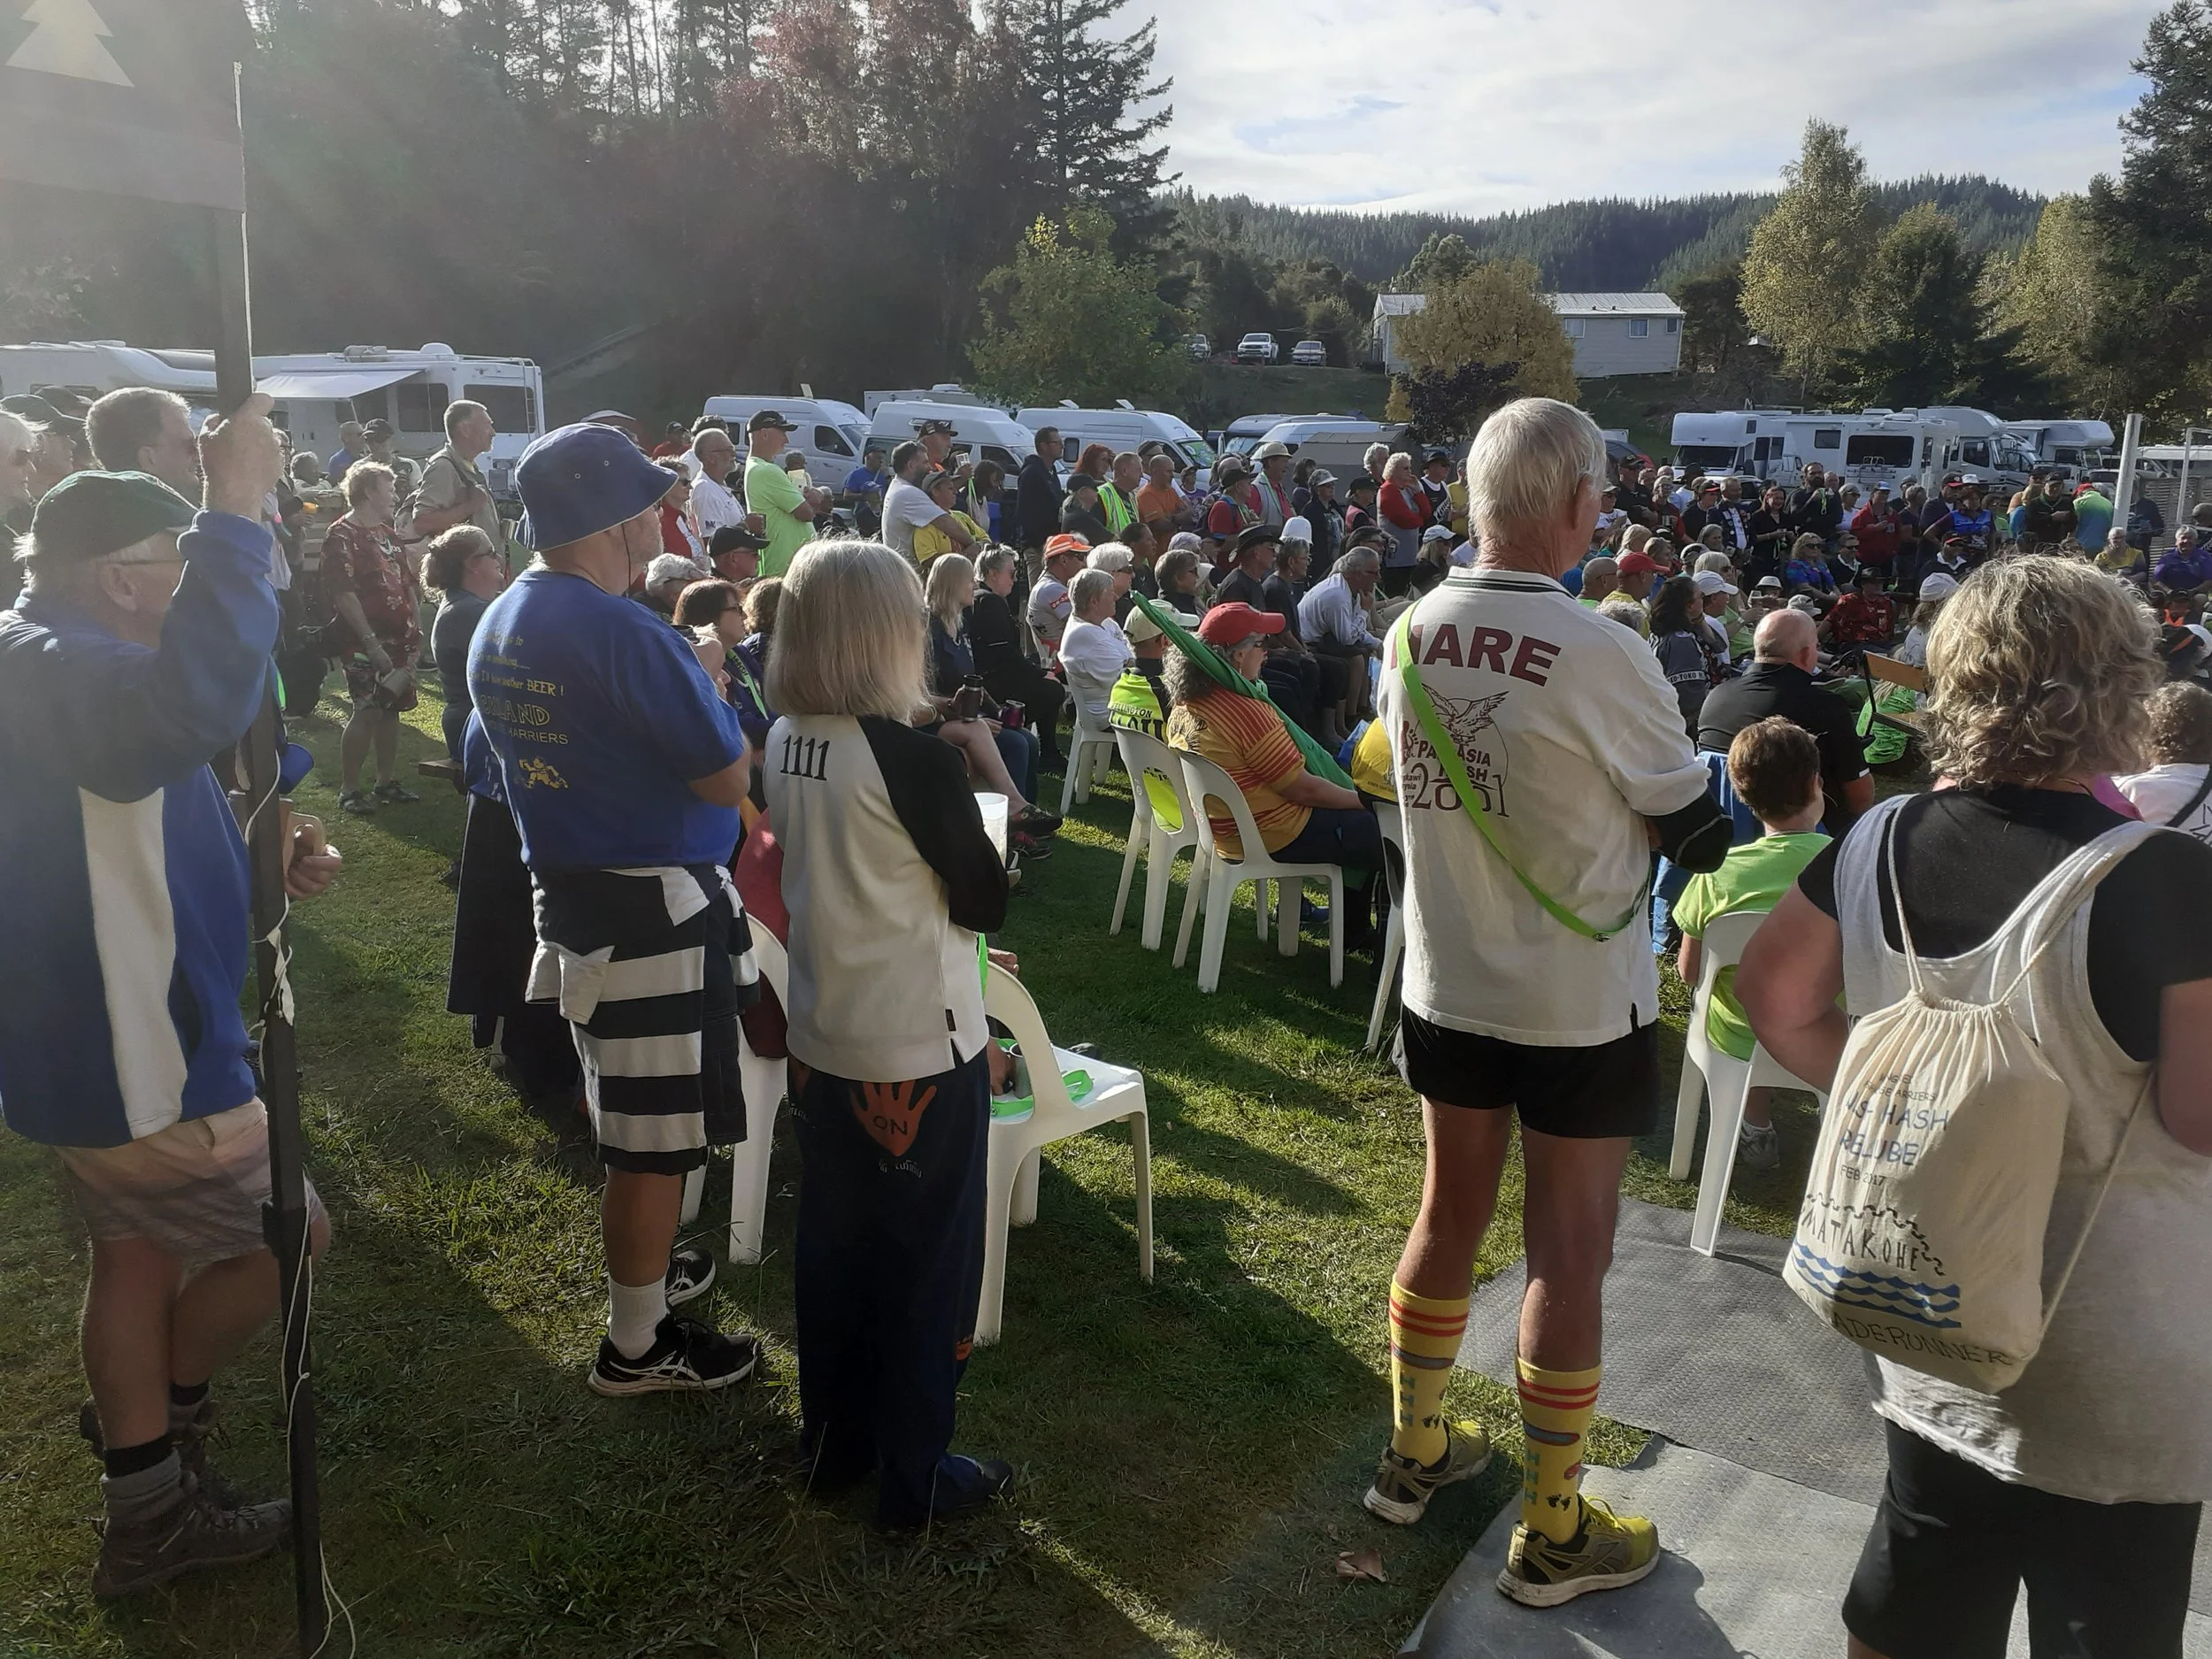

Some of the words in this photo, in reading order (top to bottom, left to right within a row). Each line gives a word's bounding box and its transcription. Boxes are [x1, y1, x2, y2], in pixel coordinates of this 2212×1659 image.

[526, 679, 557, 697] BEER
[509, 726, 569, 745] HARRIERS
[780, 734, 830, 781] 1111
[1417, 740, 1440, 759] PA
[1456, 743, 1492, 767] ASIA
[872, 1115, 908, 1136] ON
[1880, 1103, 1949, 1131] HASH
[1840, 1164, 1861, 1181] FEB
[1801, 1206, 1919, 1271] MATAKOHE
